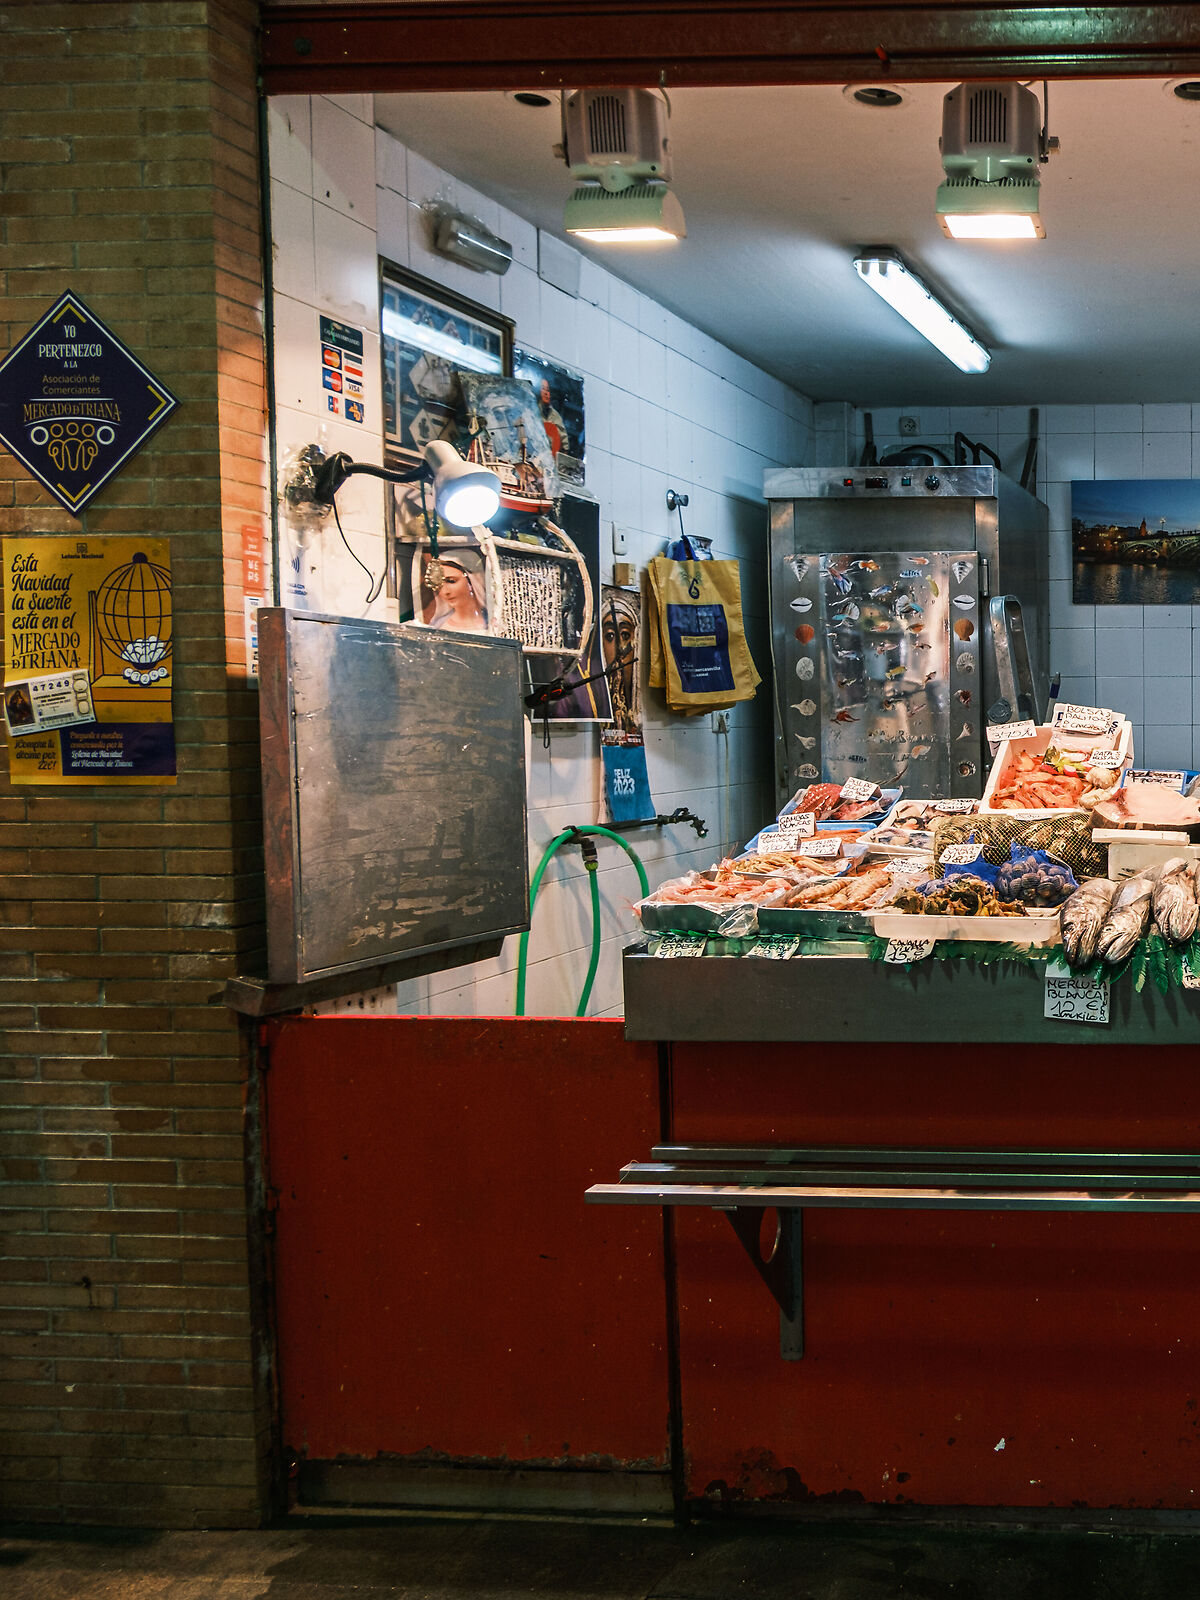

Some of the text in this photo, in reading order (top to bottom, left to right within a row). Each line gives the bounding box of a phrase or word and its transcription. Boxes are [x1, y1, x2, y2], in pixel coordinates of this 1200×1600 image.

[64, 325, 76, 338] YO
[39, 344, 102, 359] PERTENEZCO
[42, 374, 100, 383] Asociación de
[42, 386, 101, 395] Comerciantes
[24, 402, 72, 422] MERCADO
[11, 553, 38, 572] Esta
[12, 573, 73, 591] Navidad
[12, 591, 72, 610] la Suerte
[42, 612, 77, 629] en el
[11, 632, 80, 657] MERCADO
[33, 680, 69, 692] 47249
[614, 768, 631, 779] FELIZ
[613, 778, 635, 795] 2023
[780, 813, 810, 824] GAMBAS
[1047, 989, 1102, 1000] BLANCA
[1086, 1000, 1099, 1011] €
